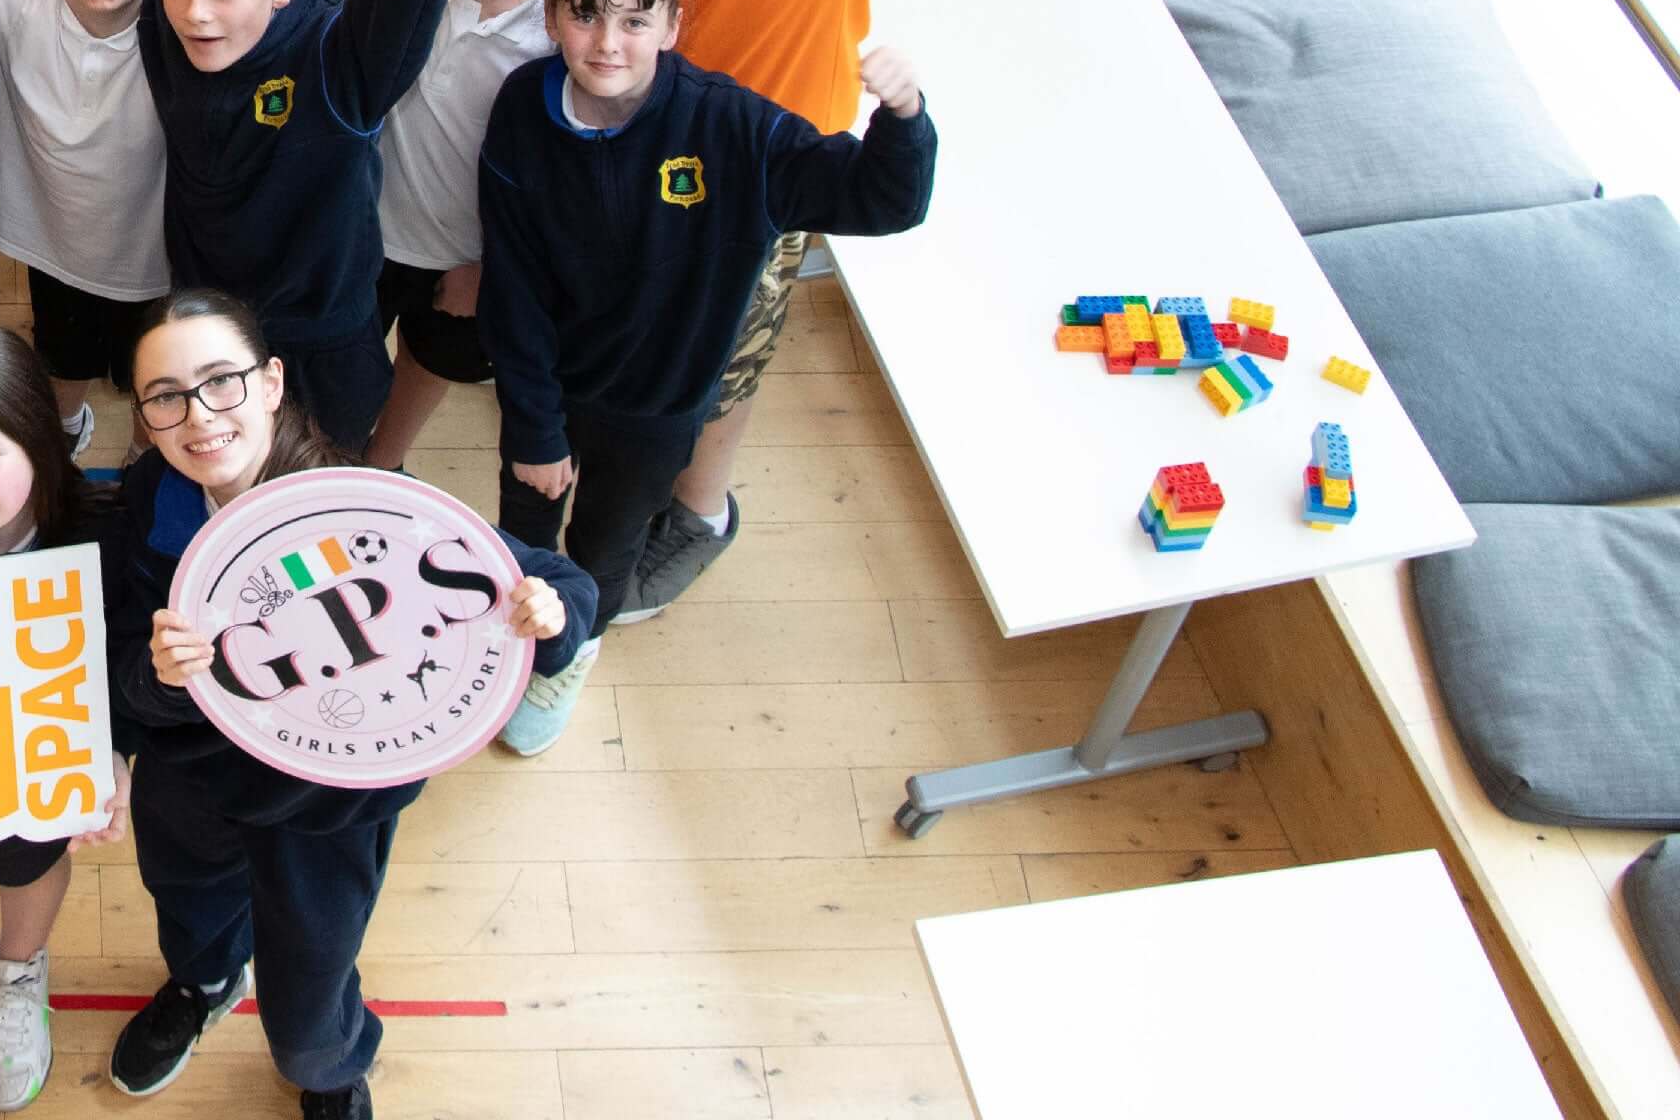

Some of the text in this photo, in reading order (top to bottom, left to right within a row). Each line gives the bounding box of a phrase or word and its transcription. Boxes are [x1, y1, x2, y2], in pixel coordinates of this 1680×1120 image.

[12, 568, 97, 821] SPACE
[209, 536, 502, 702] G.P.S
[277, 646, 501, 756] GIRLS PLAY SPORT
